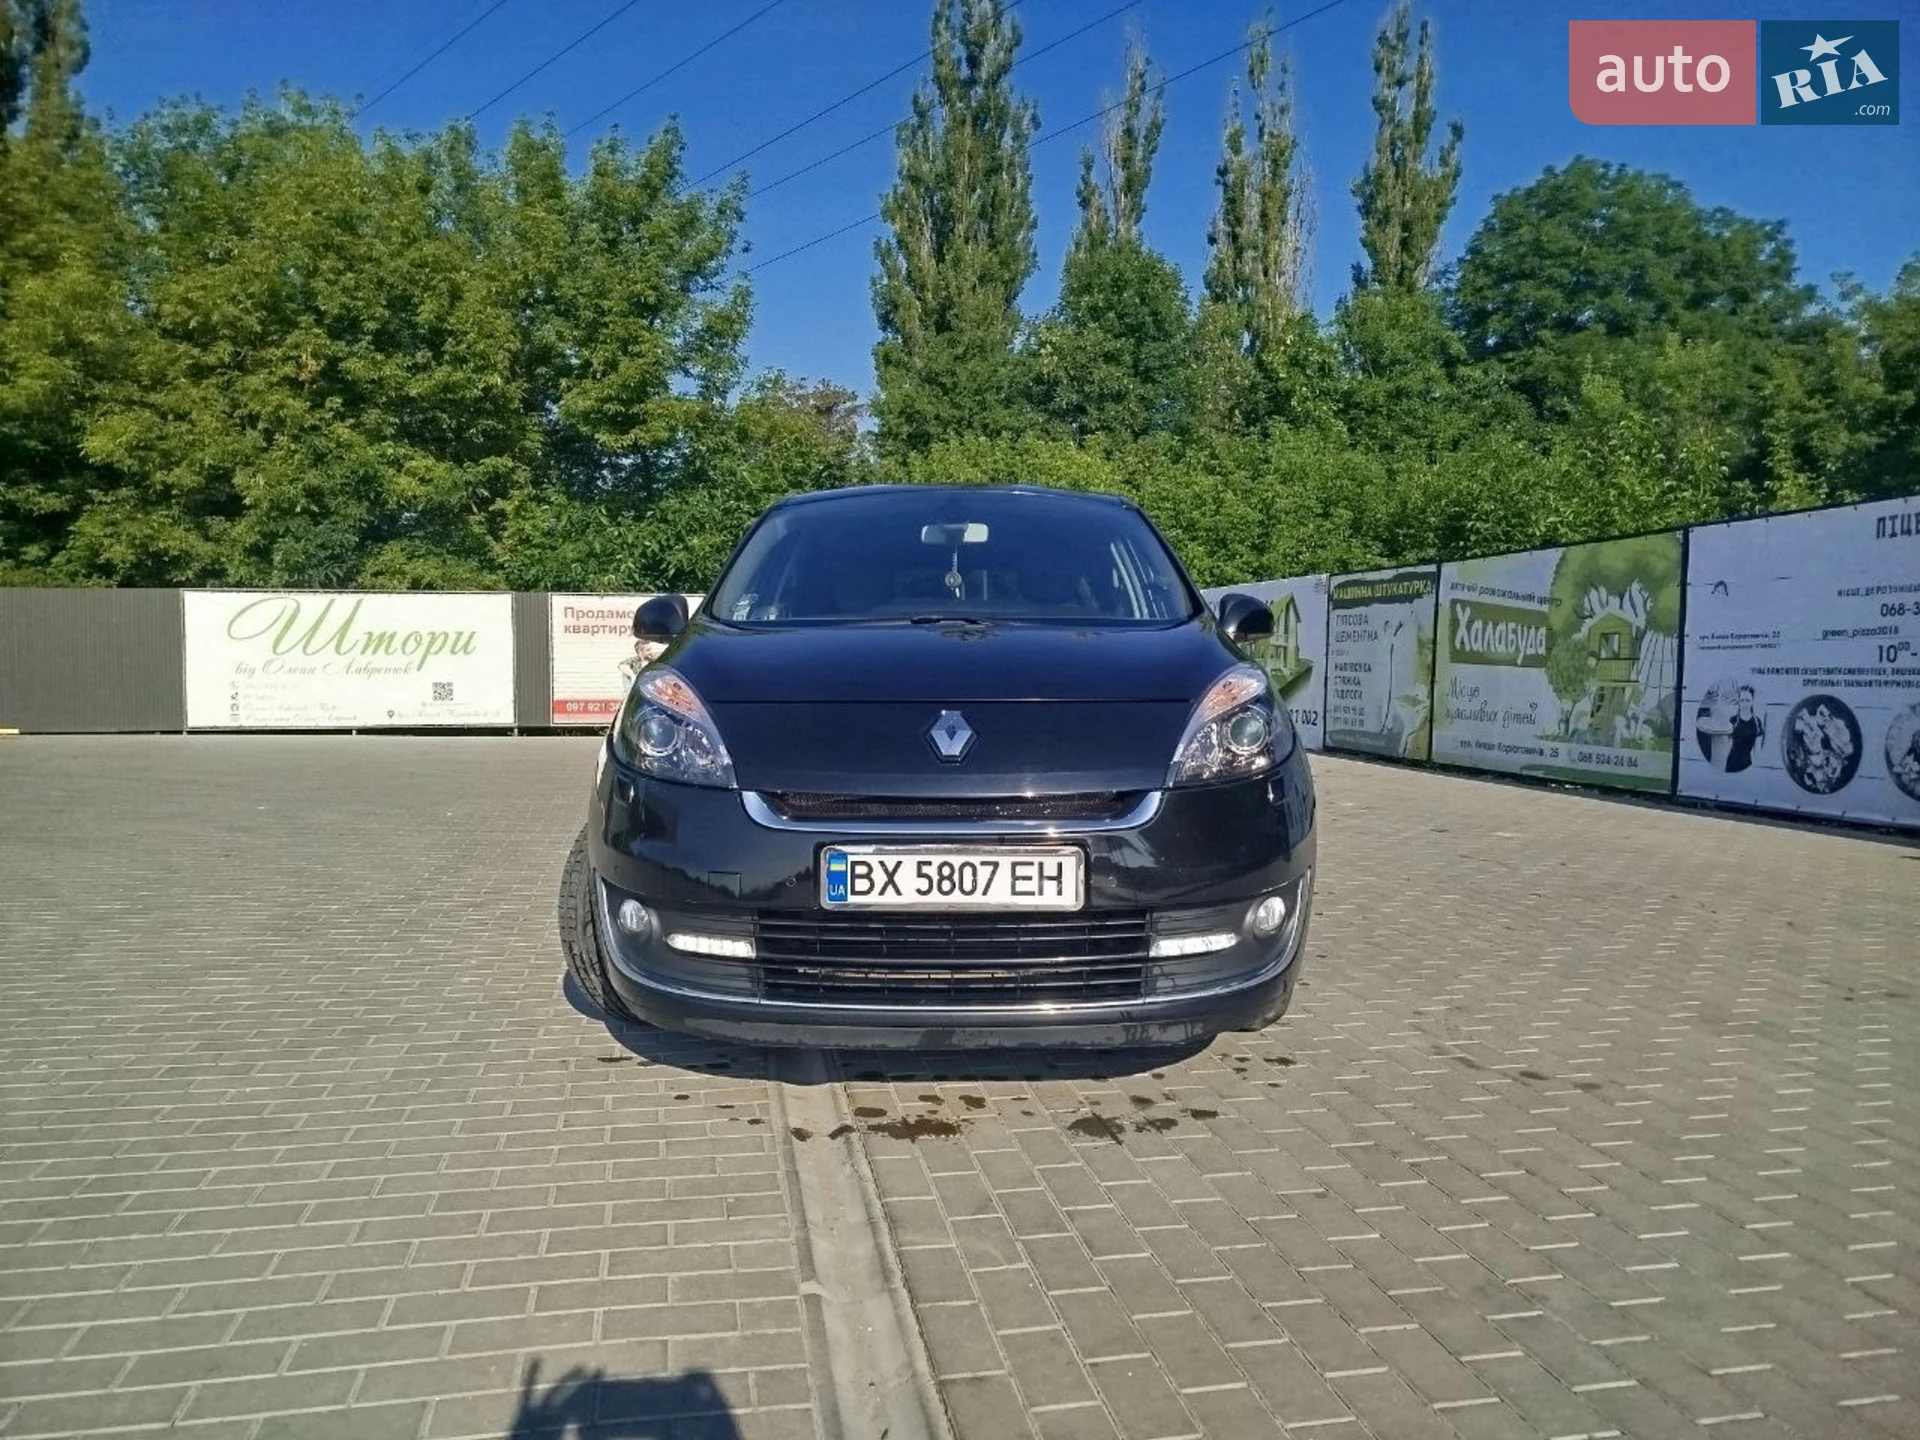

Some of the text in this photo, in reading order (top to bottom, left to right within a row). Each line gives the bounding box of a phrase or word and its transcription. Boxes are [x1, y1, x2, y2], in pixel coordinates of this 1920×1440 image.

[227, 596, 477, 672] Штори
[1455, 603, 1547, 666] Халабуда
[829, 860, 1063, 897] UA BX 5807 EH
